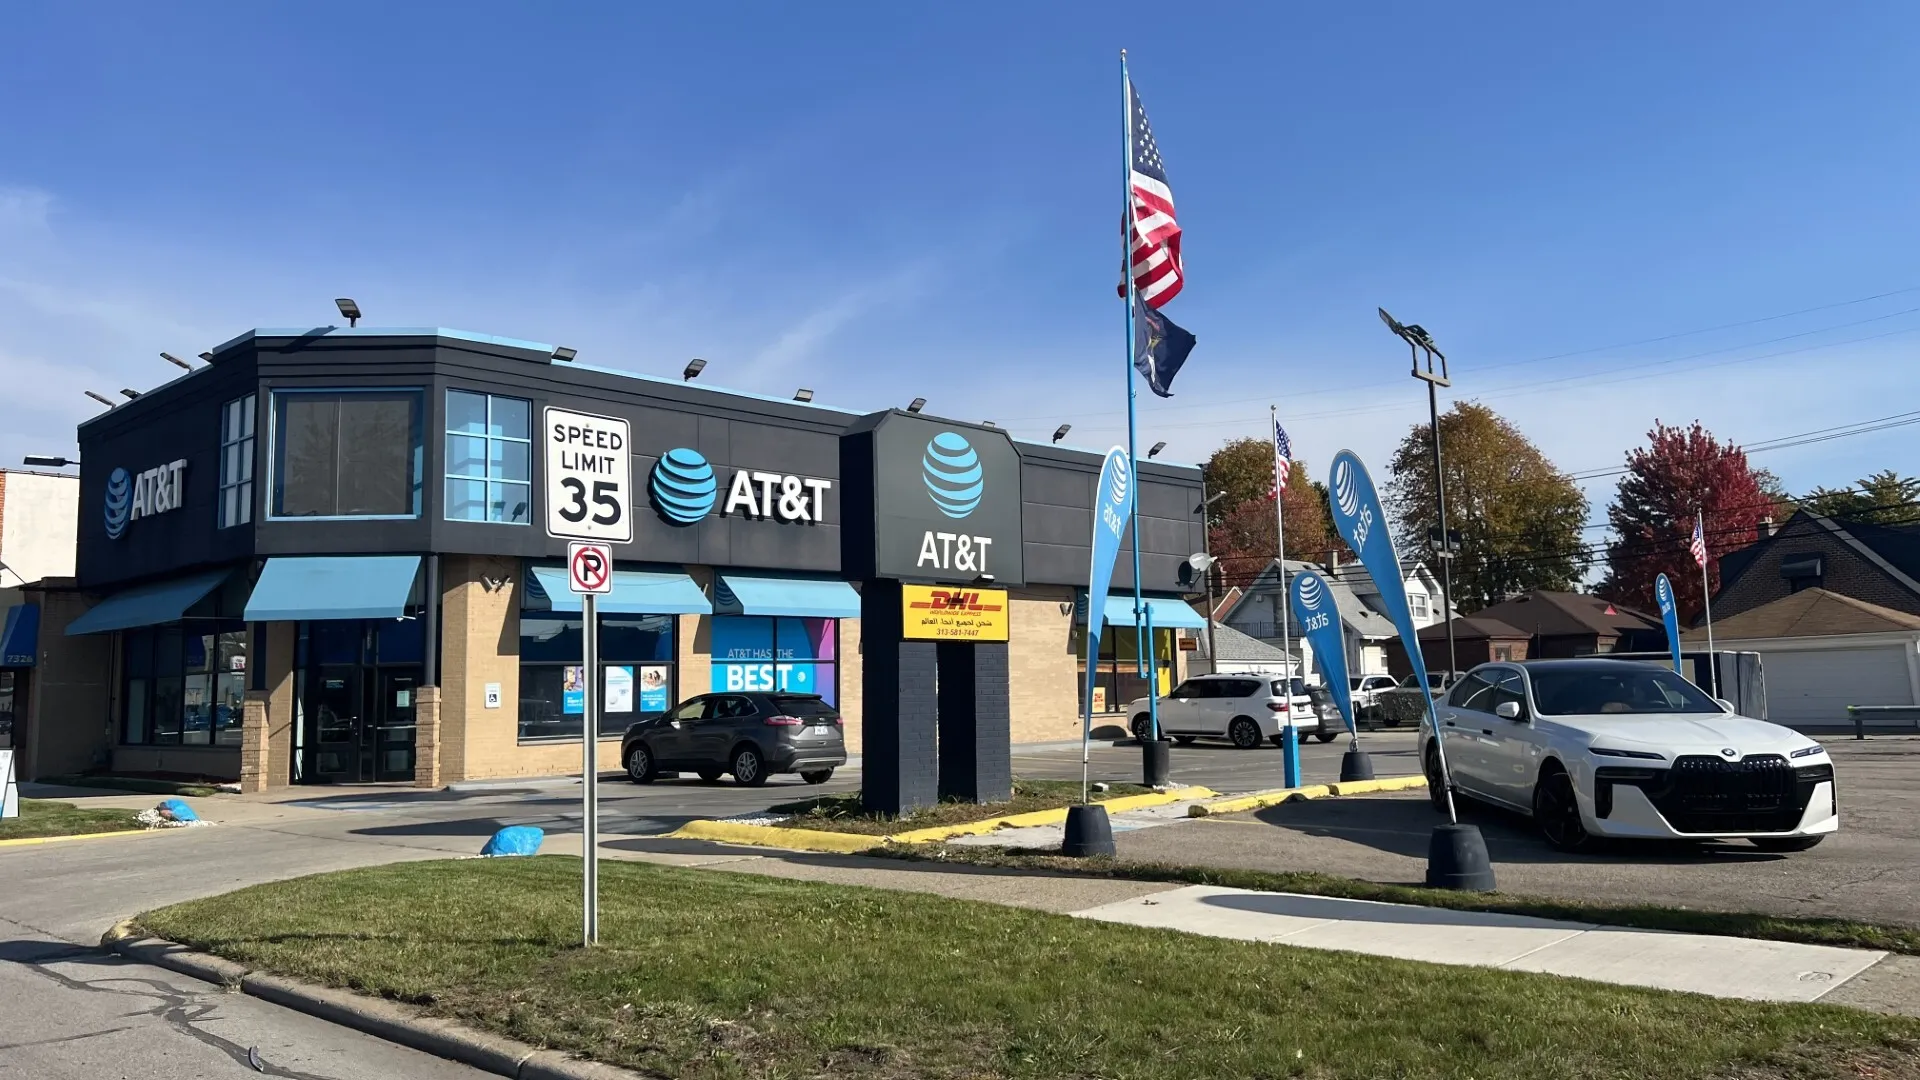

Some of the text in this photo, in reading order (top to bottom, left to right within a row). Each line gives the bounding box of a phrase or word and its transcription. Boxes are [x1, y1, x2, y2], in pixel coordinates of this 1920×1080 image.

[553, 424, 623, 450] SPEED
[561, 450, 615, 475] LIMIT
[130, 458, 187, 520] AT&T
[558, 477, 622, 525] 35
[725, 470, 831, 521] AT&T
[1103, 502, 1121, 540] at&t
[916, 531, 992, 572] AT&T
[583, 554, 602, 581] P
[930, 591, 984, 611] DHL
[936, 628, 980, 637] 313-581-7447
[727, 648, 794, 658] AT&T HAS THE
[727, 664, 793, 691] BEST
